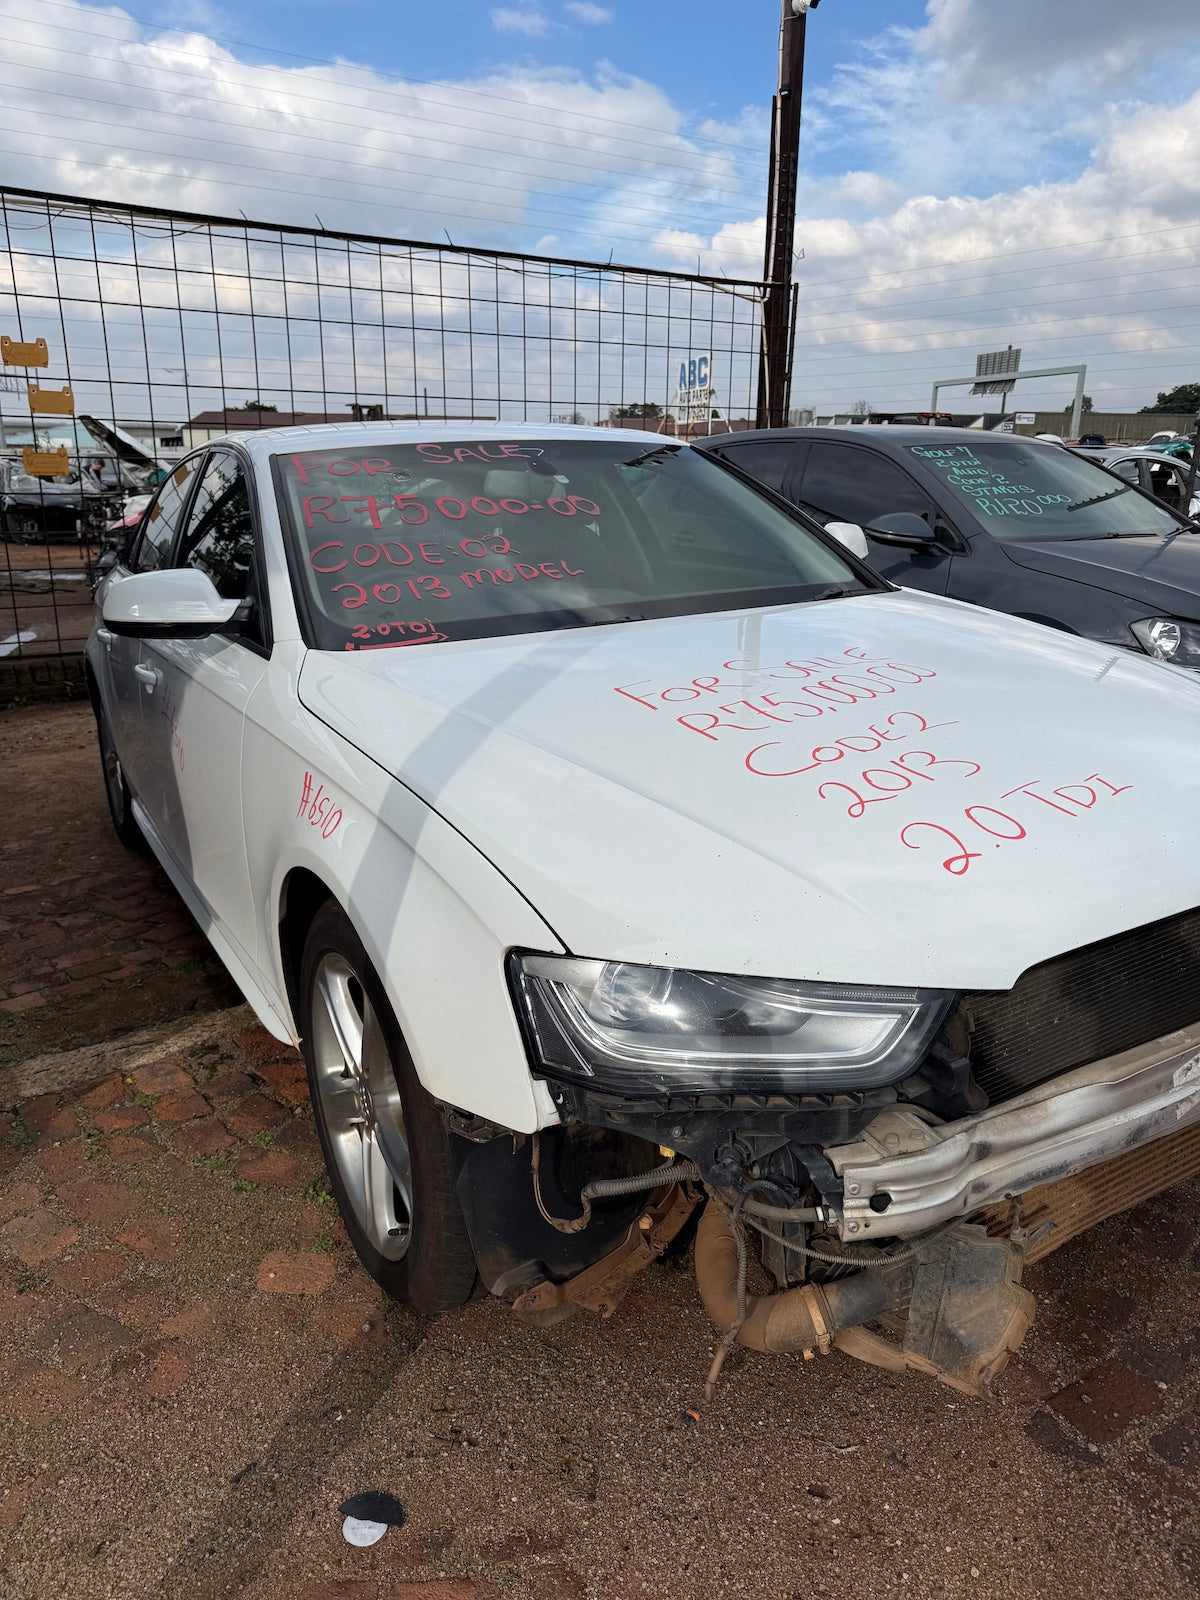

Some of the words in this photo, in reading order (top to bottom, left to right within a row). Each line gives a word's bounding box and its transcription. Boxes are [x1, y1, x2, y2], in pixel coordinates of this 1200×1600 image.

[679, 356, 708, 391] ABC
[290, 454, 394, 484] FOR
[415, 444, 529, 464] SALE
[911, 446, 957, 458] GOLF
[955, 446, 974, 458] 7
[947, 474, 991, 486] CODE
[951, 467, 989, 476] AUTO
[961, 484, 1036, 498] STARTS
[331, 575, 451, 609] 2013
[459, 560, 586, 591] MODEL
[613, 675, 752, 711] FOR
[723, 646, 895, 680] SALE
[818, 749, 981, 818] 2013
[900, 803, 1027, 876] 2.0
[1000, 772, 1134, 818] TDI
